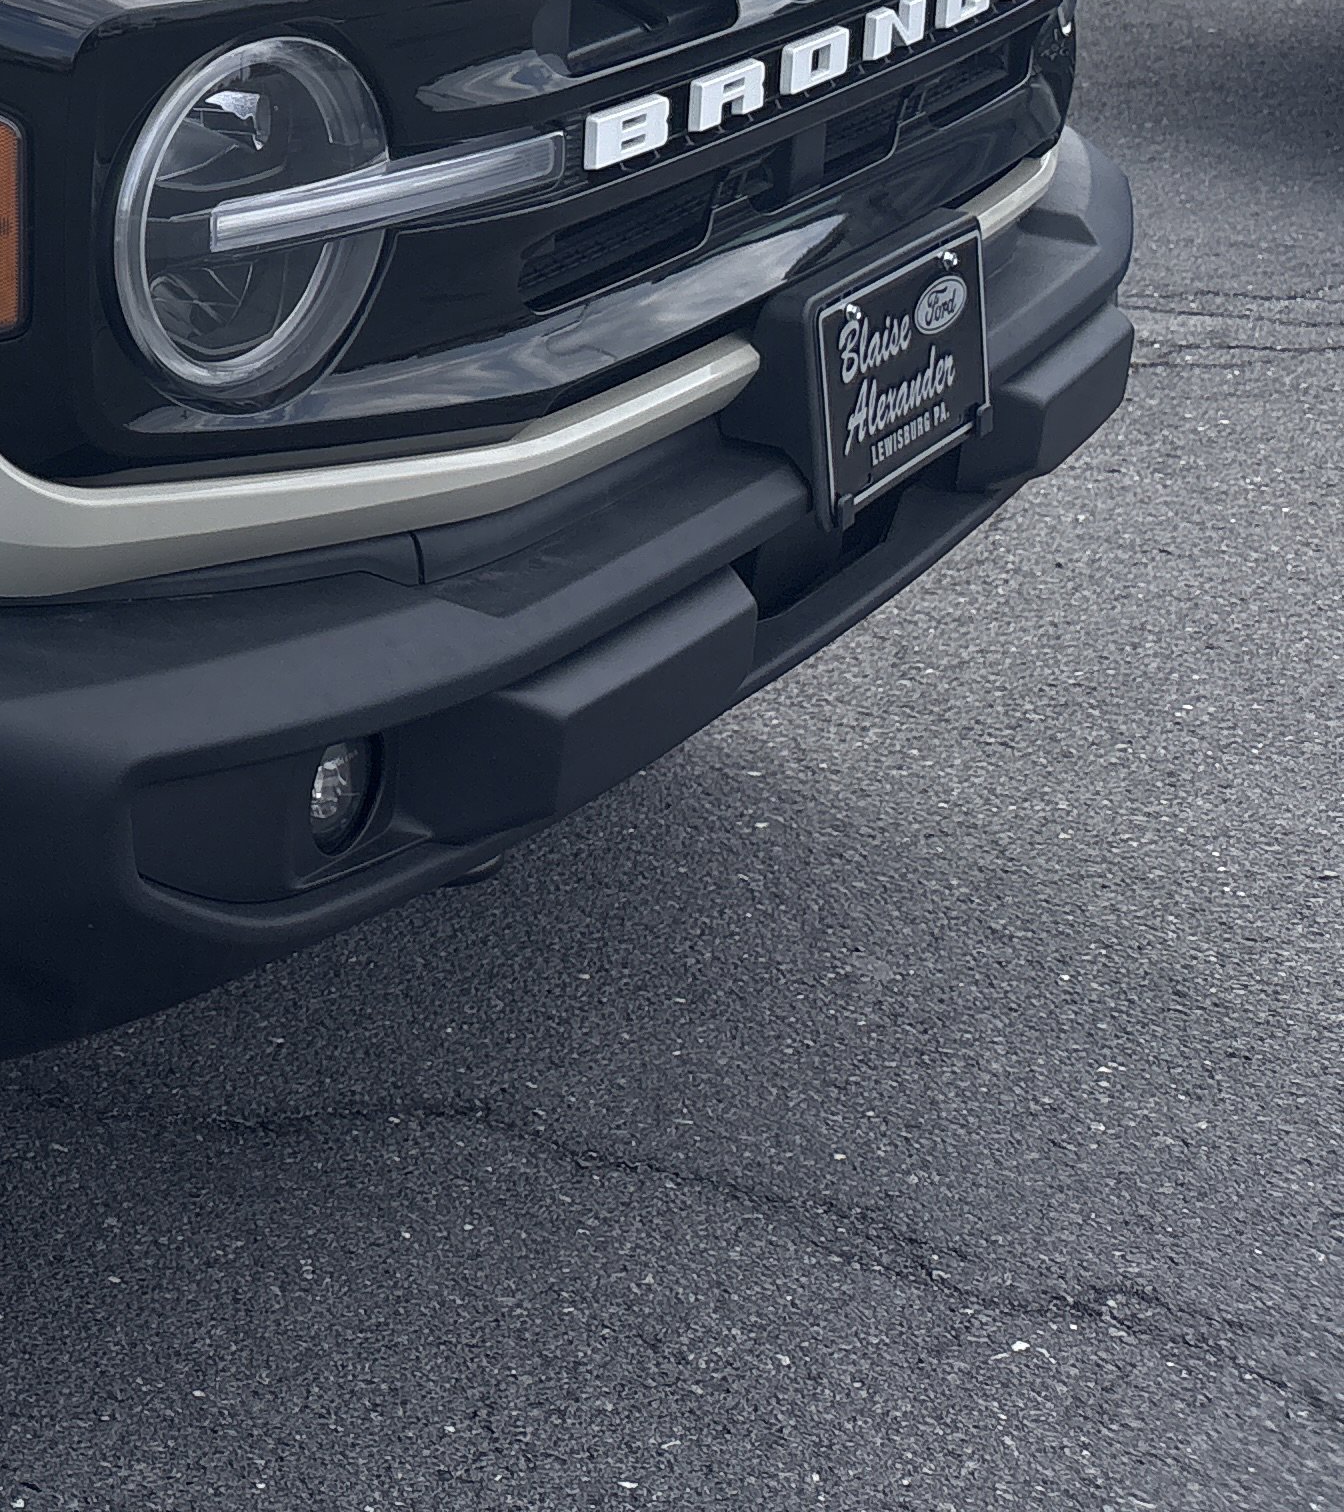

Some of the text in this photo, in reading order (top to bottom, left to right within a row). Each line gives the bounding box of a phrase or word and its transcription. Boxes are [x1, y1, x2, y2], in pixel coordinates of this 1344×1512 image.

[924, 285, 959, 327] Ford
[838, 314, 912, 384] Blaise
[844, 344, 956, 456] Alexander
[870, 408, 932, 467] LEWISBURG
